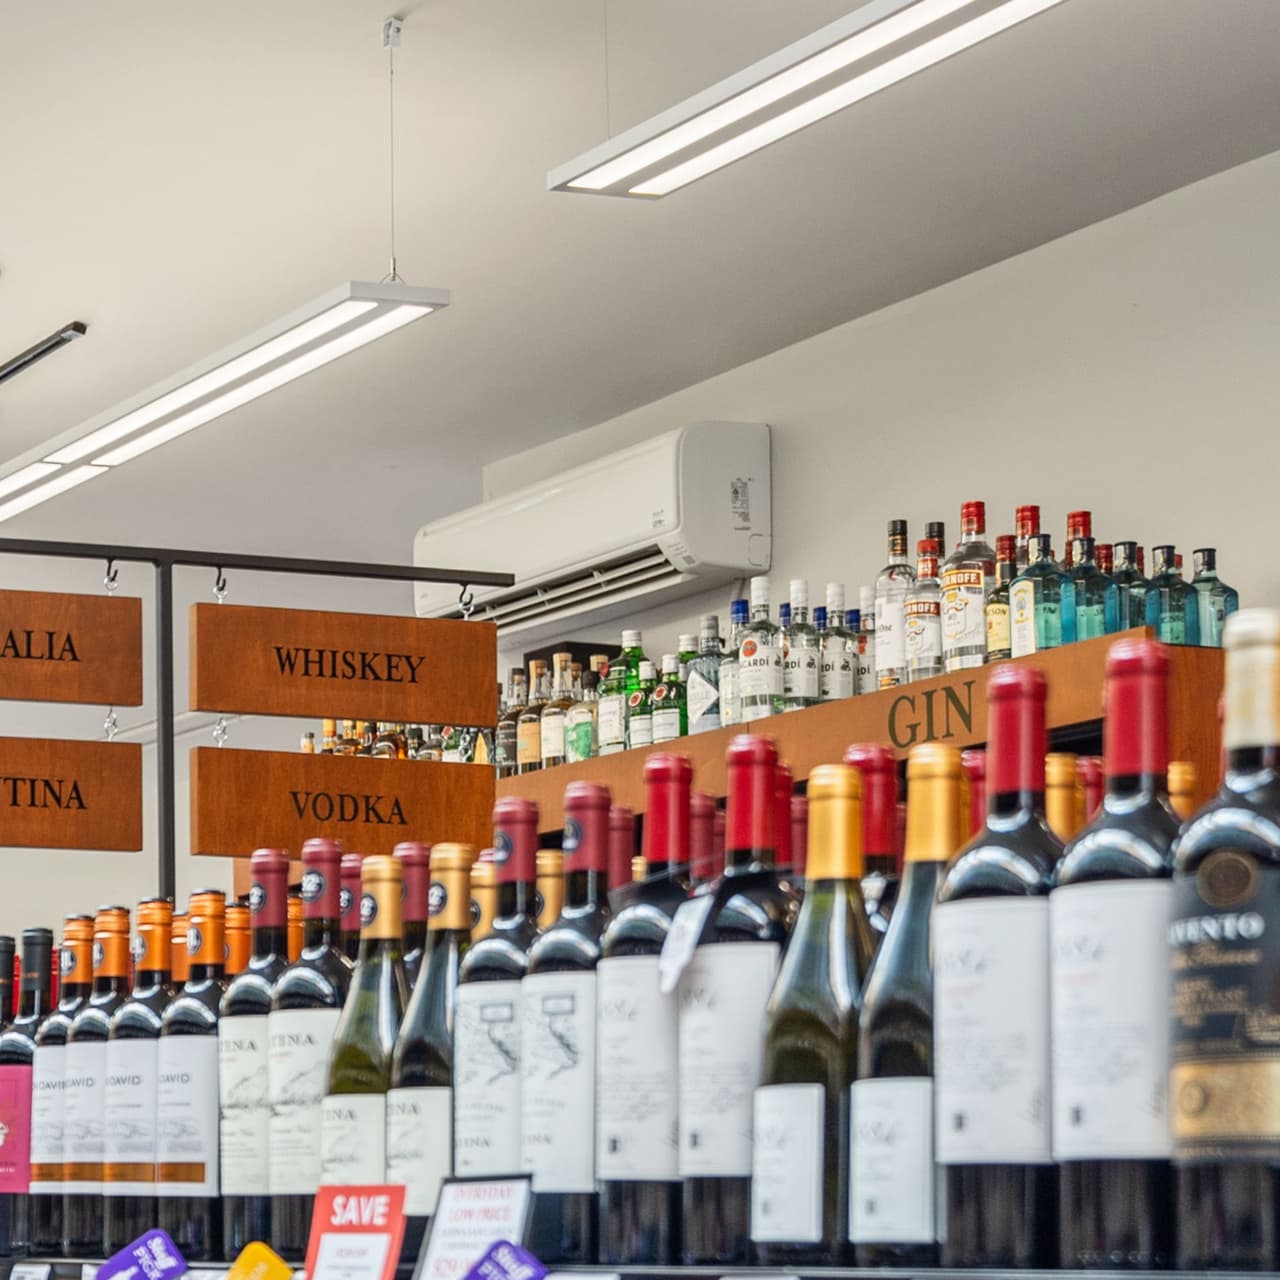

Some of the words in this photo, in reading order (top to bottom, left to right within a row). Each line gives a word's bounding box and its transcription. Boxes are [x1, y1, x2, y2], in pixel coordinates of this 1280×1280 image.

[273, 644, 426, 685] WHISKEY
[887, 684, 976, 748] GIN
[289, 790, 408, 826] VODKA
[330, 1195, 389, 1226] SAVE
